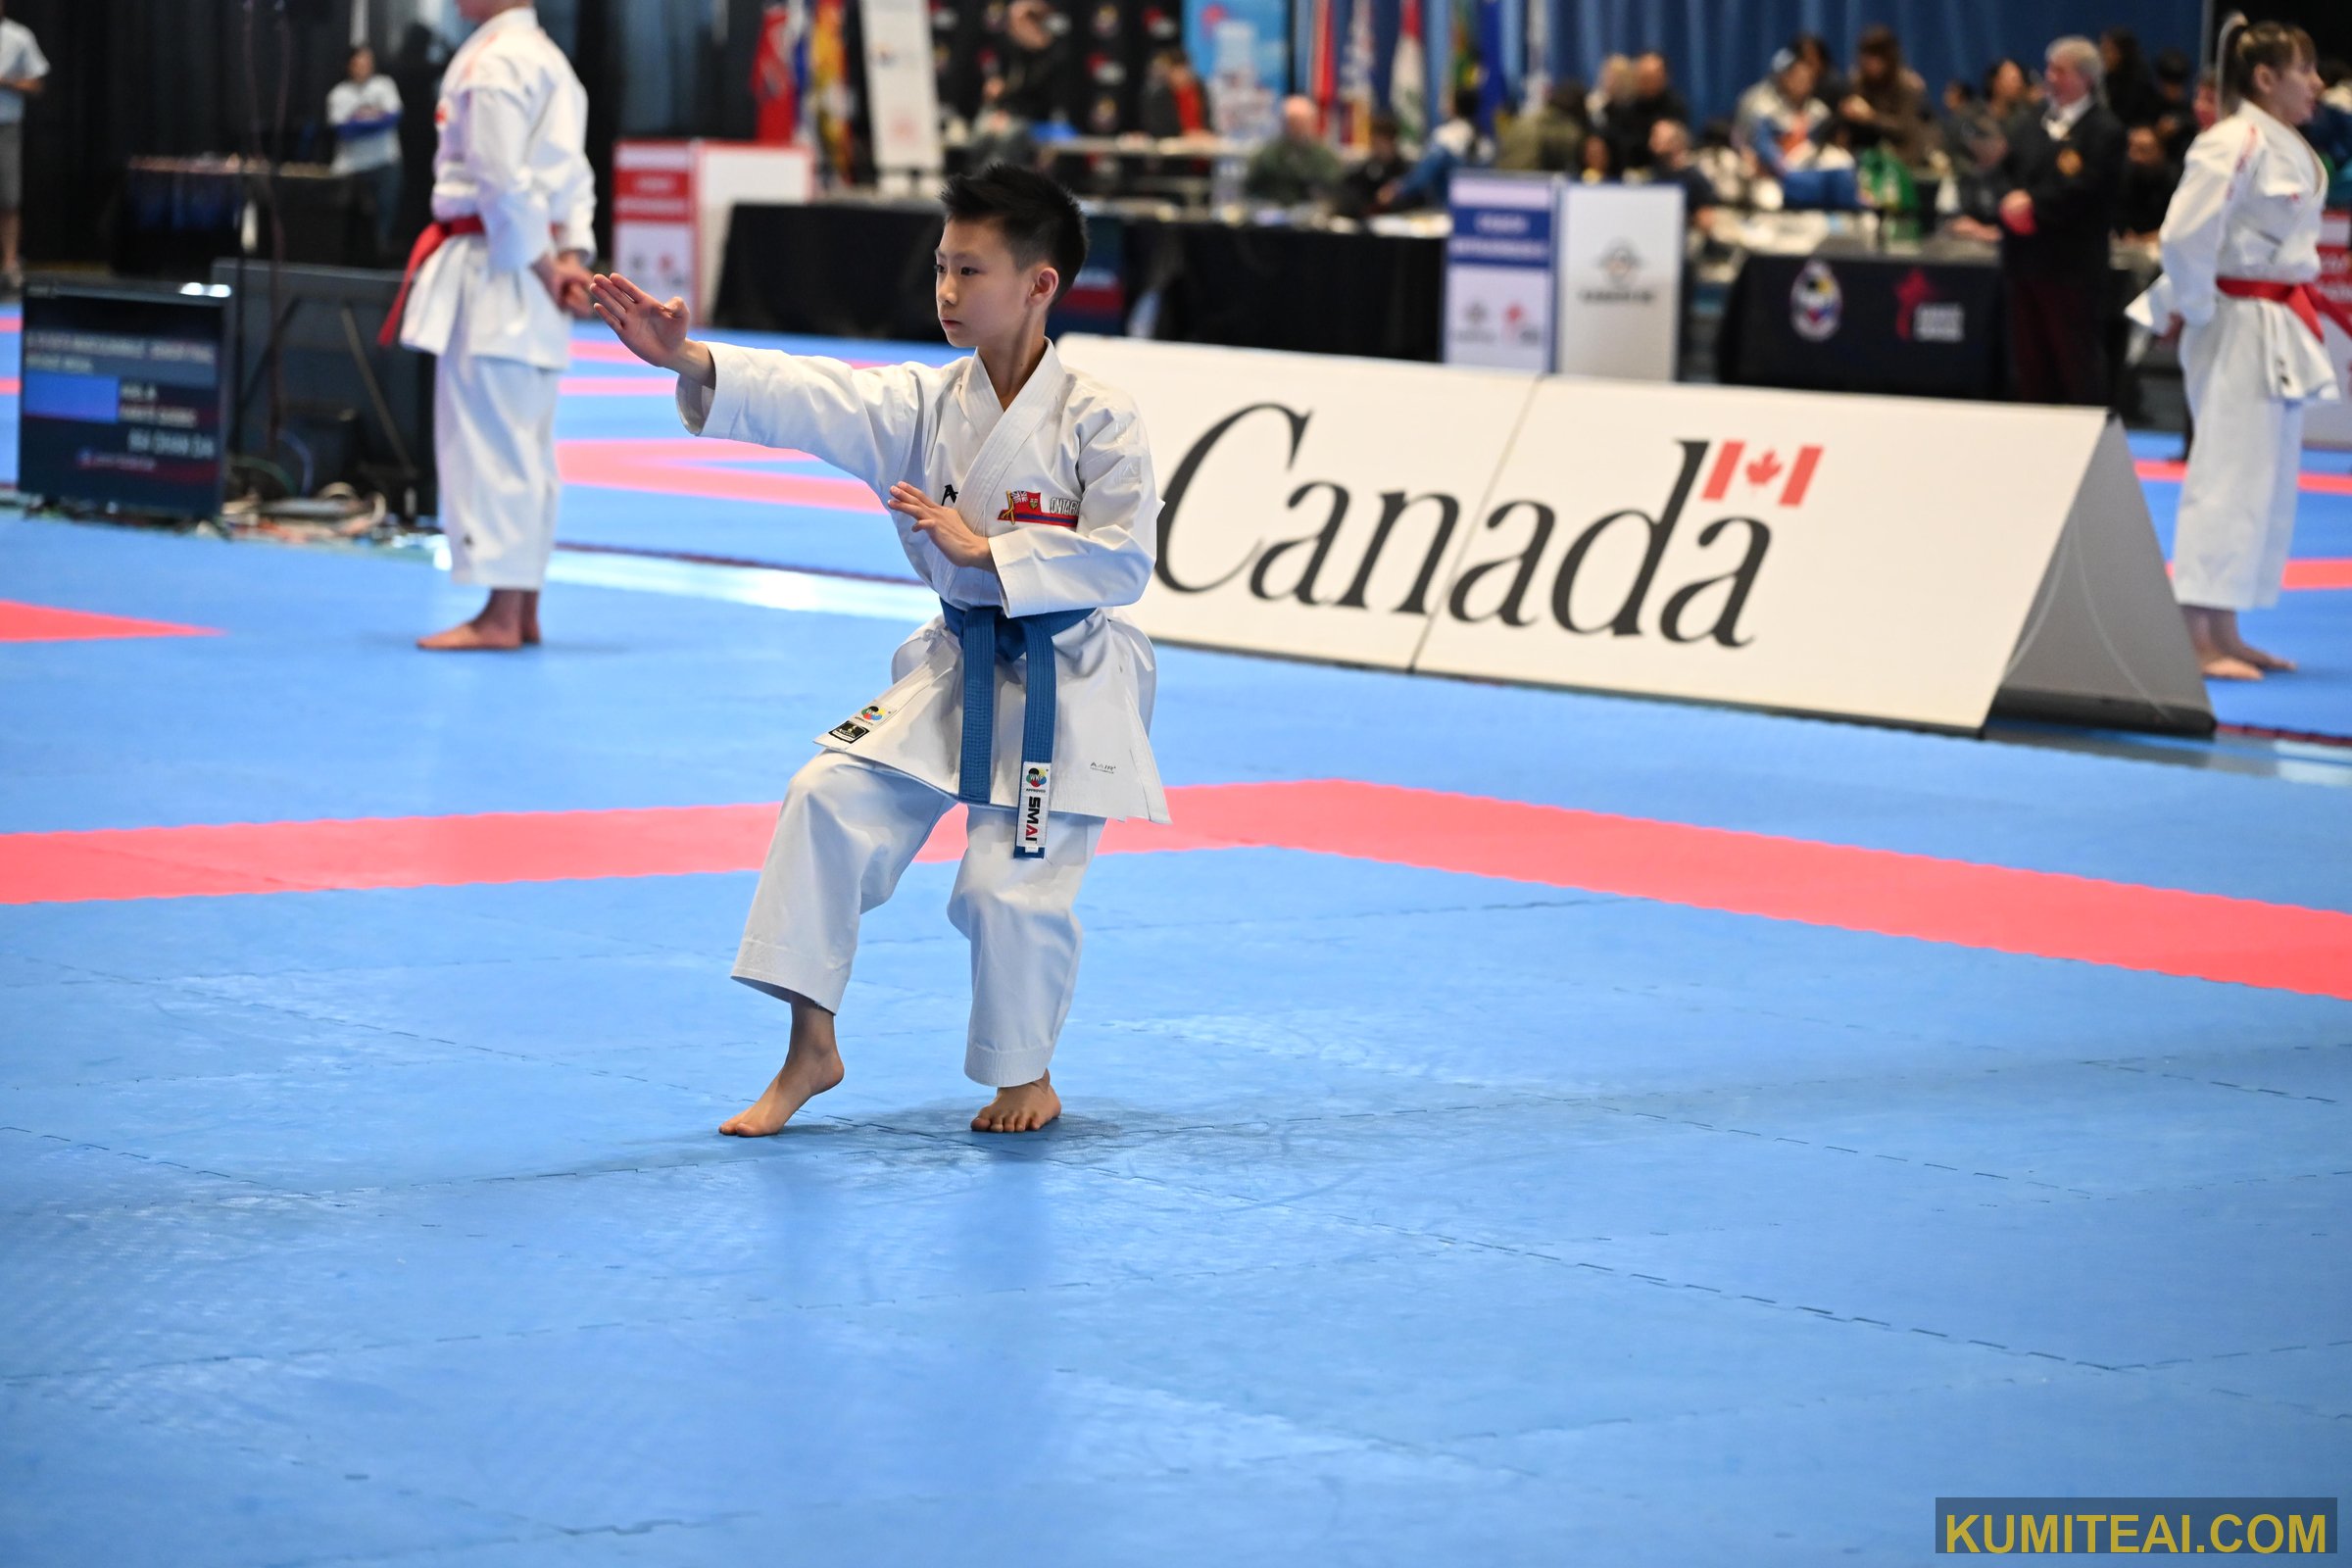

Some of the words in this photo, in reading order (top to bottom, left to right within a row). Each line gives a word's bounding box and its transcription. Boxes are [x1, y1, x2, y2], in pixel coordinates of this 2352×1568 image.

[1050, 497, 1081, 516] ONTARI
[1154, 402, 1772, 648] Canada
[1025, 796, 1042, 841] SMAI
